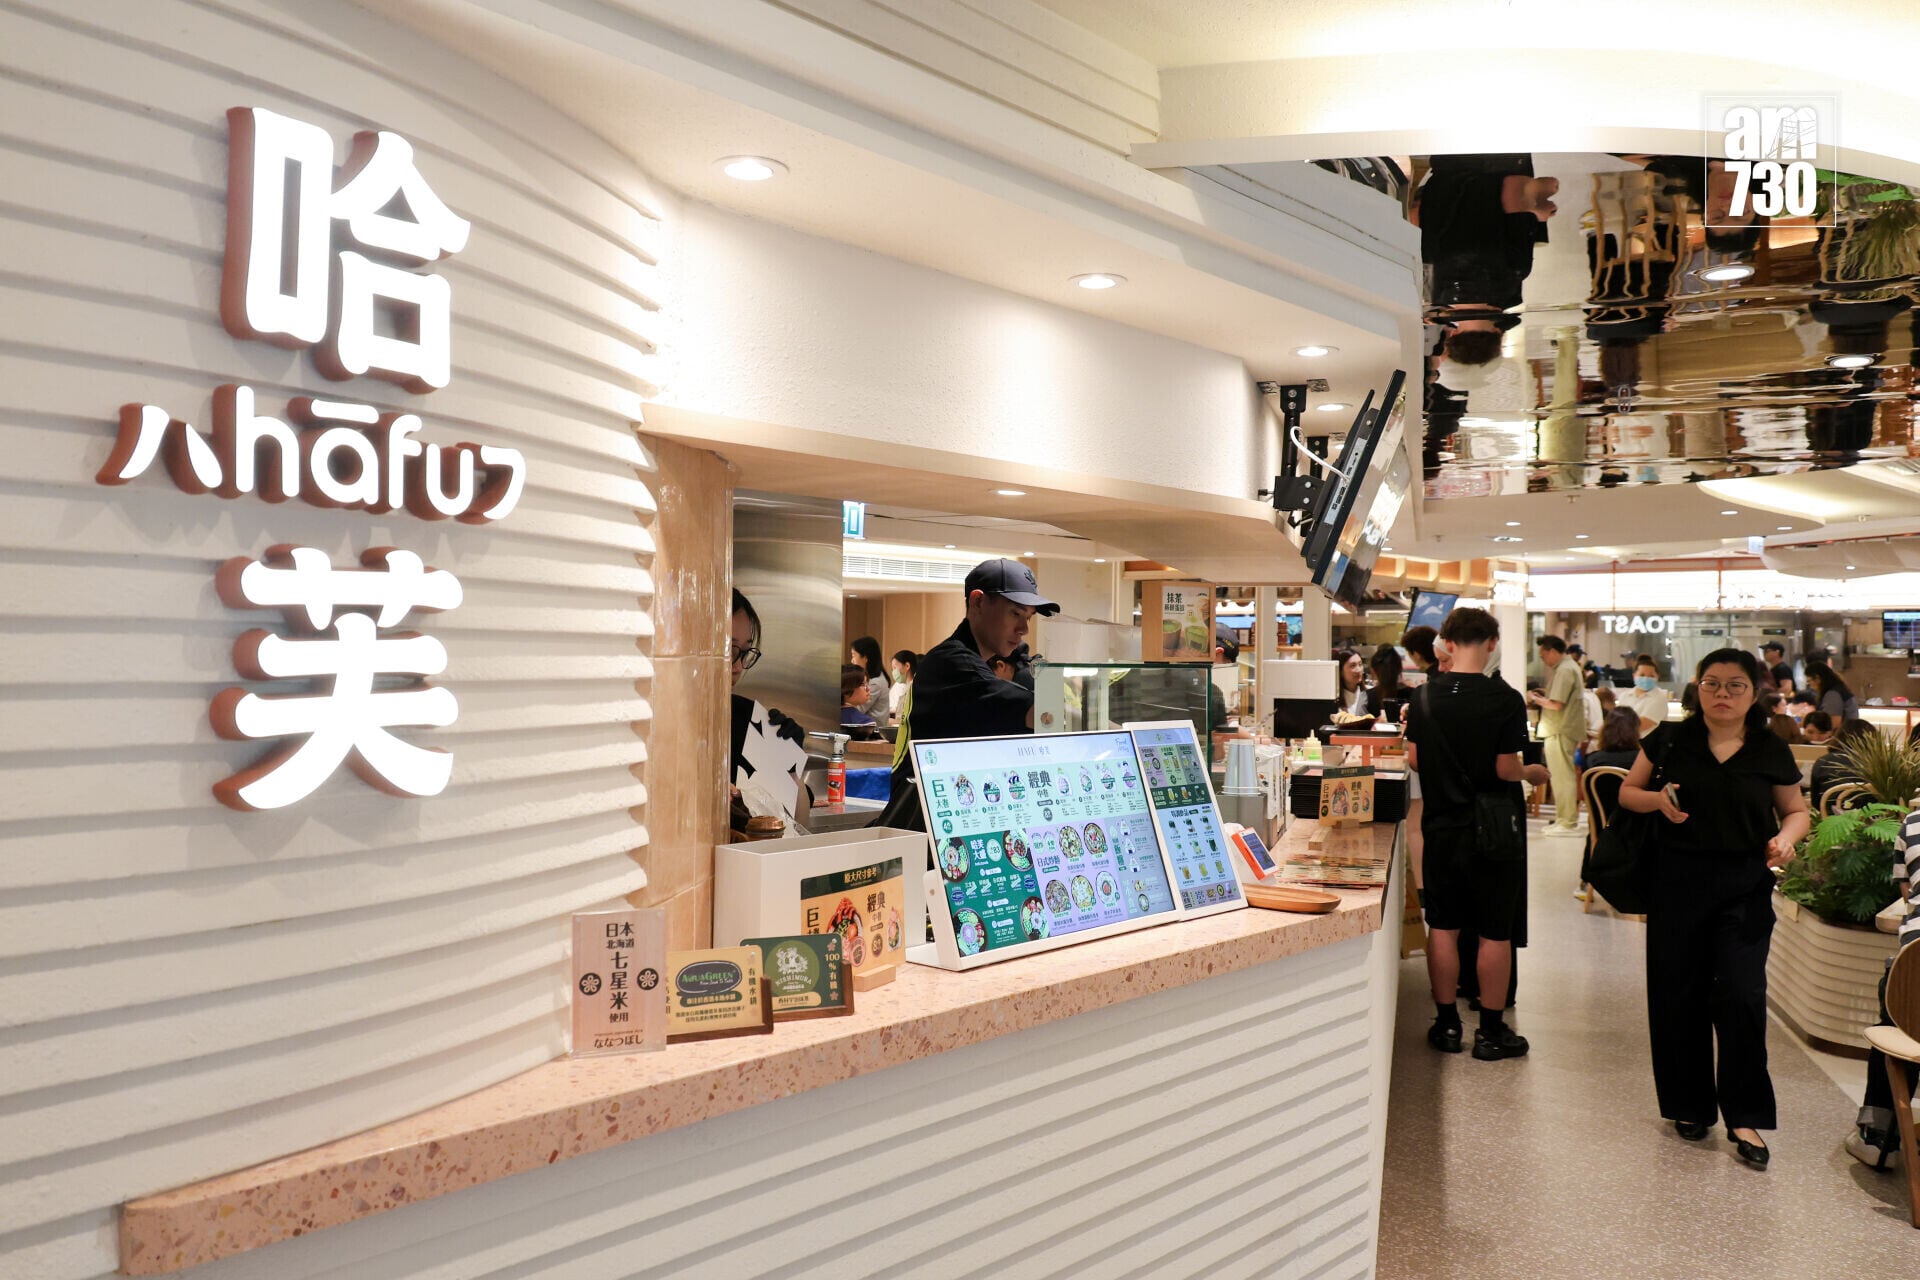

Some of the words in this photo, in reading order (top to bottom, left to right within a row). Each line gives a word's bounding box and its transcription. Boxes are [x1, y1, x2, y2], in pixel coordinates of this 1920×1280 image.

[246, 105, 471, 390] 哈
[235, 546, 464, 810] 芙
[932, 779, 946, 798] 巨
[1028, 770, 1053, 788] 經典
[867, 891, 886, 913] 經典
[807, 907, 819, 928] 巨
[606, 921, 635, 938] 日本
[606, 938, 635, 950] 北海道
[610, 951, 629, 1010] 七星米
[609, 1012, 629, 1024] 使用
